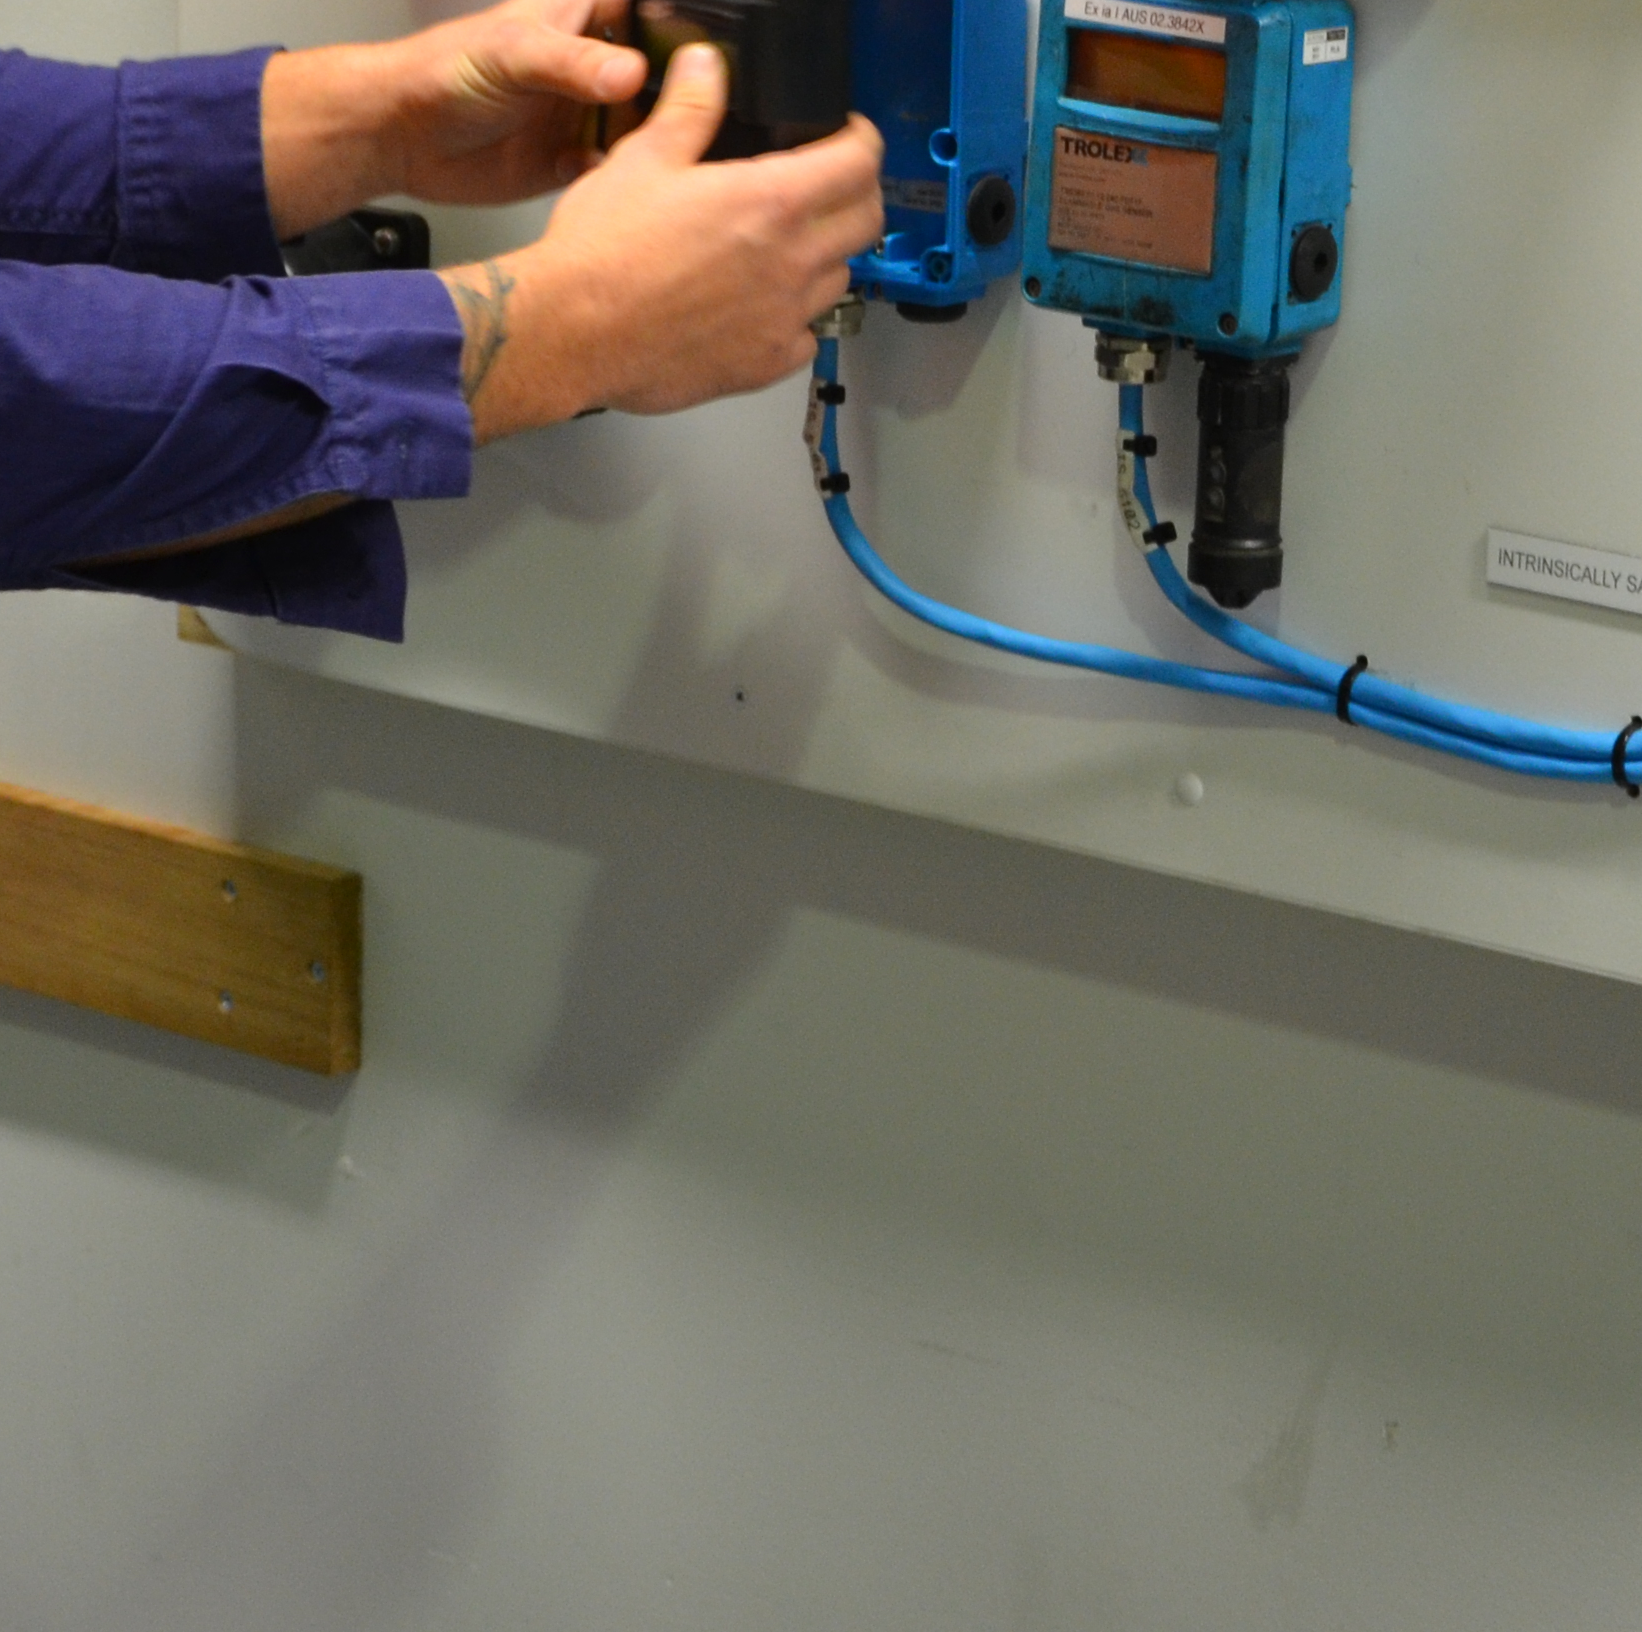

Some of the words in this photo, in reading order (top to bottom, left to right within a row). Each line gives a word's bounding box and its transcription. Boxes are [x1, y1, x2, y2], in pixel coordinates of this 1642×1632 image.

[1083, 1, 1098, 16] Ex
[1101, 6, 1111, 18] ia
[1122, 8, 1148, 25] AUS
[1497, 548, 1621, 590] INTRINSICALLY
